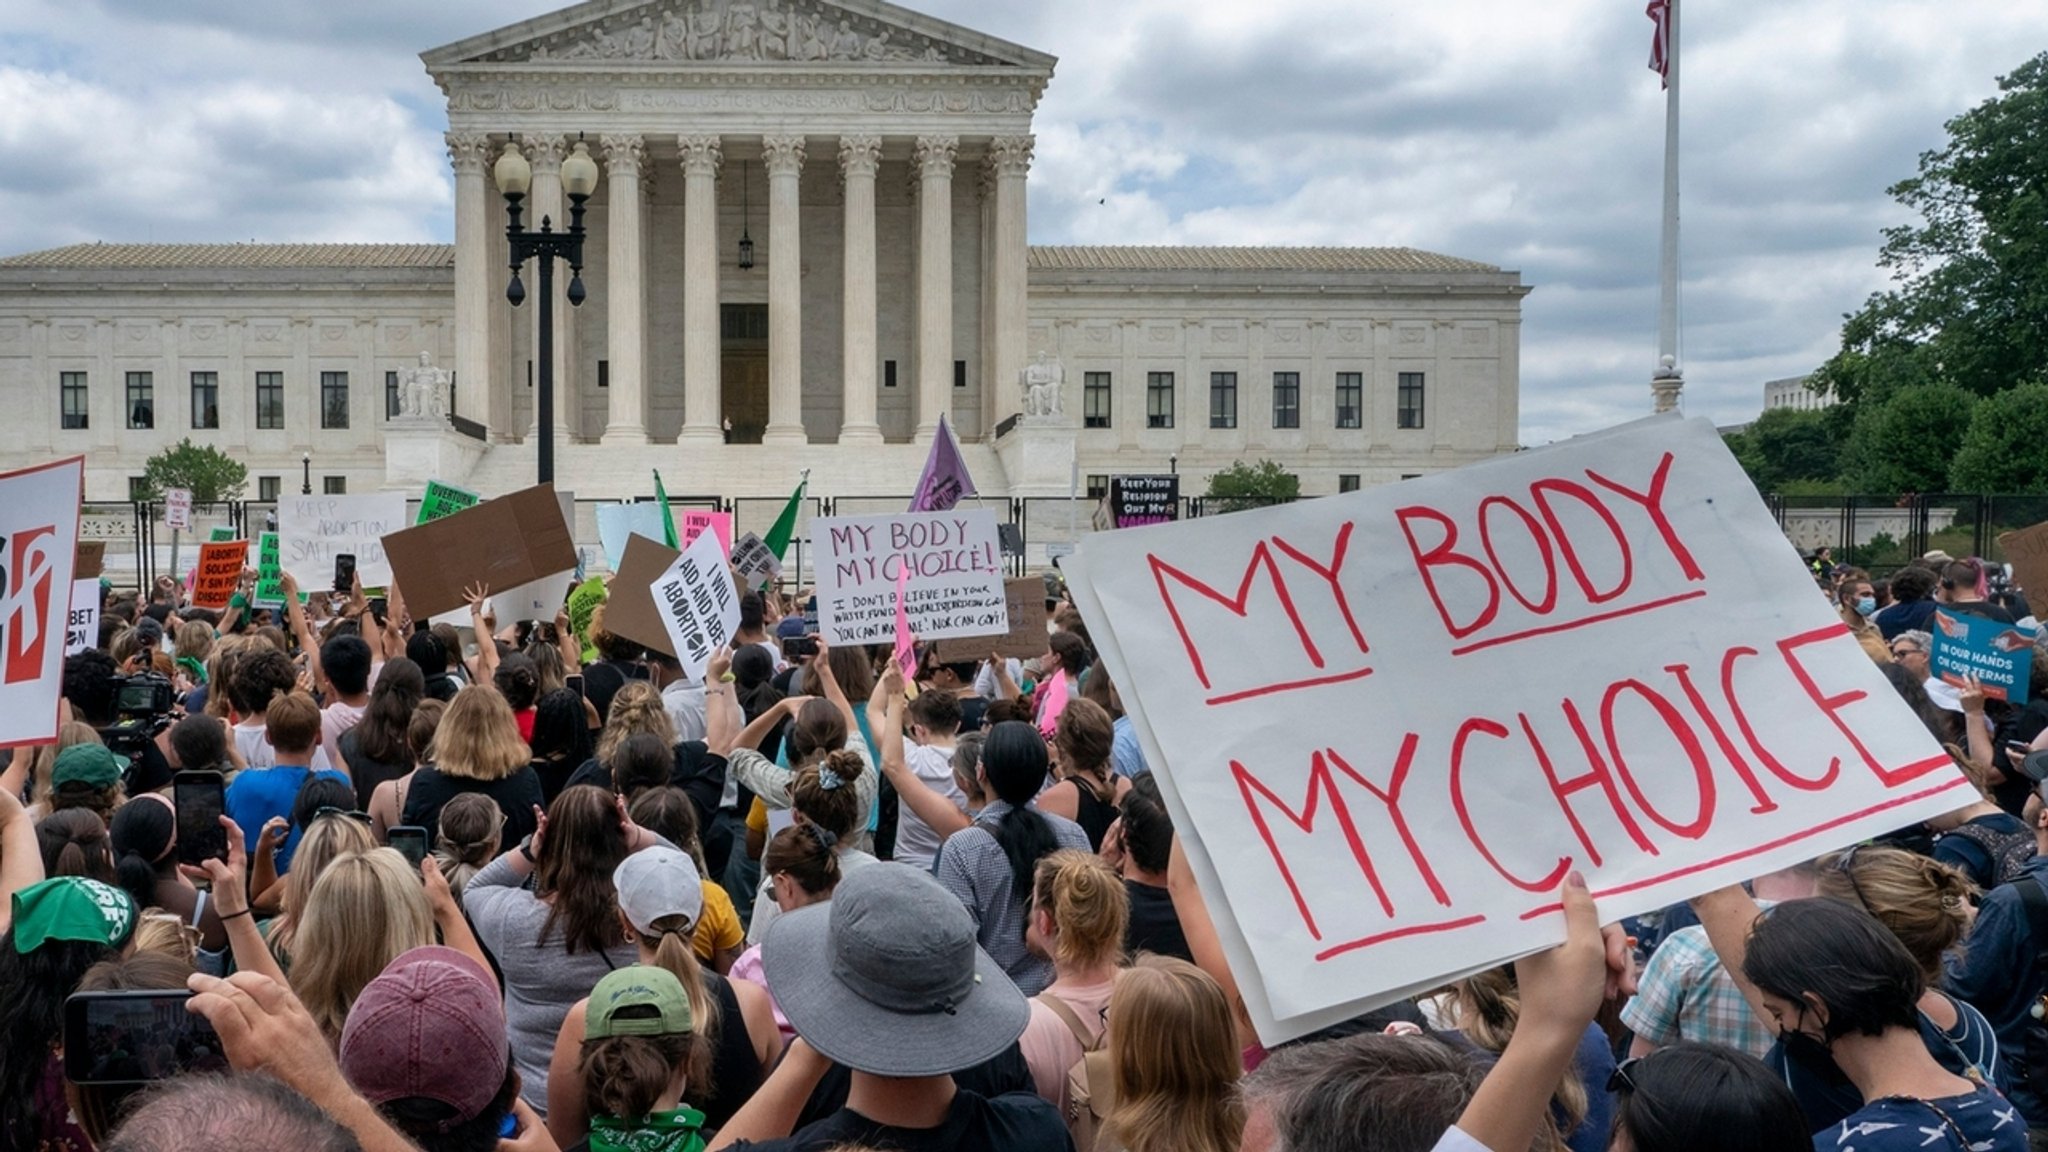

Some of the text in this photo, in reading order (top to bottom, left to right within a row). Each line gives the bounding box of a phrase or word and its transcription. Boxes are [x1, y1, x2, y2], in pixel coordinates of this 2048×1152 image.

[688, 94, 751, 107] JUSTICE
[296, 500, 337, 518] KEEP
[316, 520, 388, 537] ABORTION
[830, 519, 968, 557] MY BODY
[679, 558, 700, 586] AID
[691, 583, 714, 616] AND
[836, 556, 876, 588] MY
[1148, 453, 1705, 689] MY BODY
[711, 571, 731, 612] WILL
[853, 593, 884, 608] DON'T
[889, 586, 939, 604] BLIEVE
[943, 588, 959, 598] IN
[1940, 642, 2013, 670] IN OUR HANDS
[1230, 622, 1955, 941] MY CHOICE
